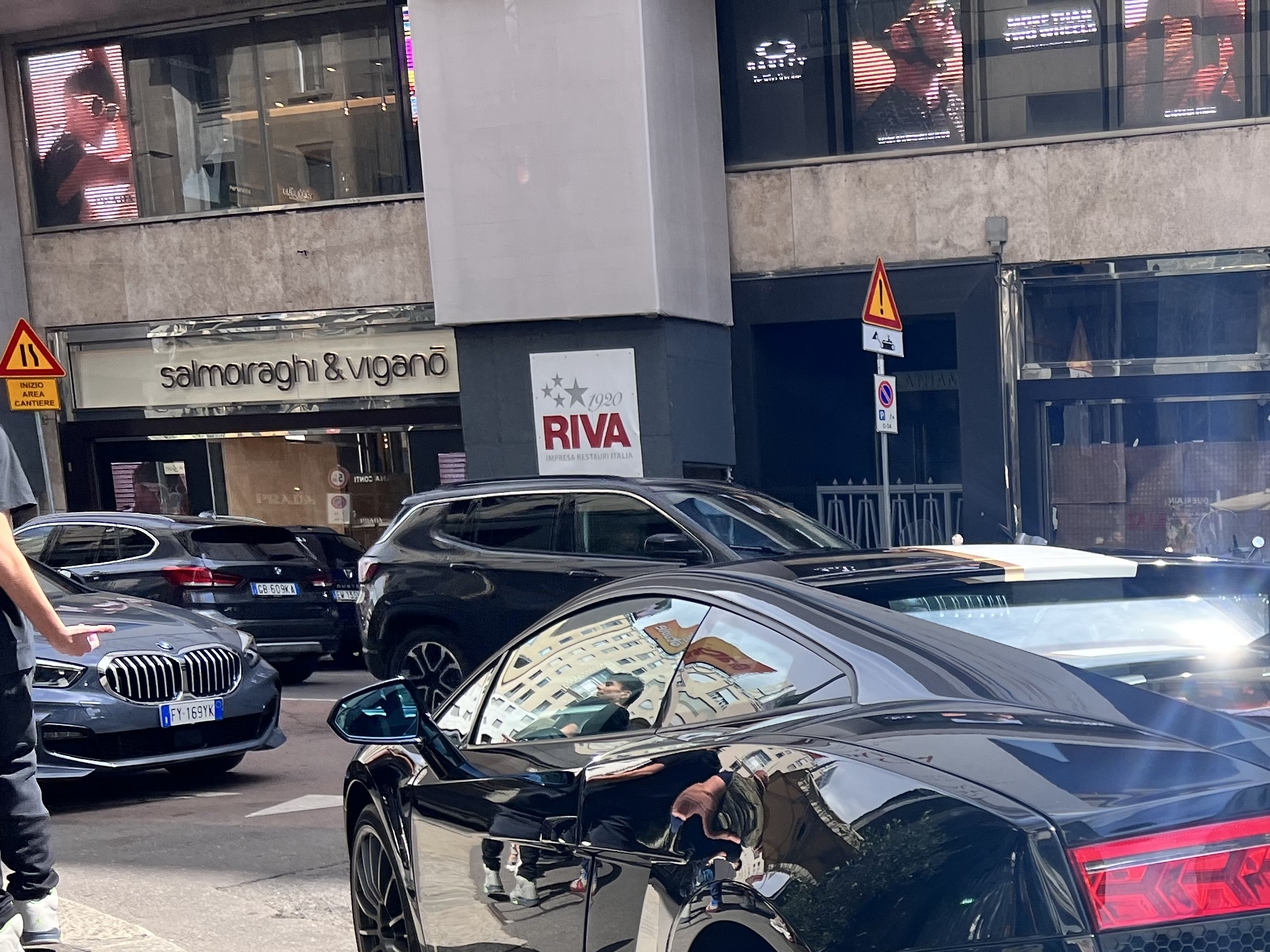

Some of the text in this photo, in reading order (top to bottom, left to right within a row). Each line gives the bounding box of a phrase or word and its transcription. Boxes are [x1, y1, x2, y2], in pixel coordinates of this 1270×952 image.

[160, 353, 318, 391] salmoiraghi
[324, 352, 347, 381] &
[588, 391, 623, 412] 1920
[543, 413, 632, 450] RIVA
[577, 453, 609, 461] RESTAURI
[611, 452, 633, 460] ITALIA
[171, 707, 183, 722] FY
